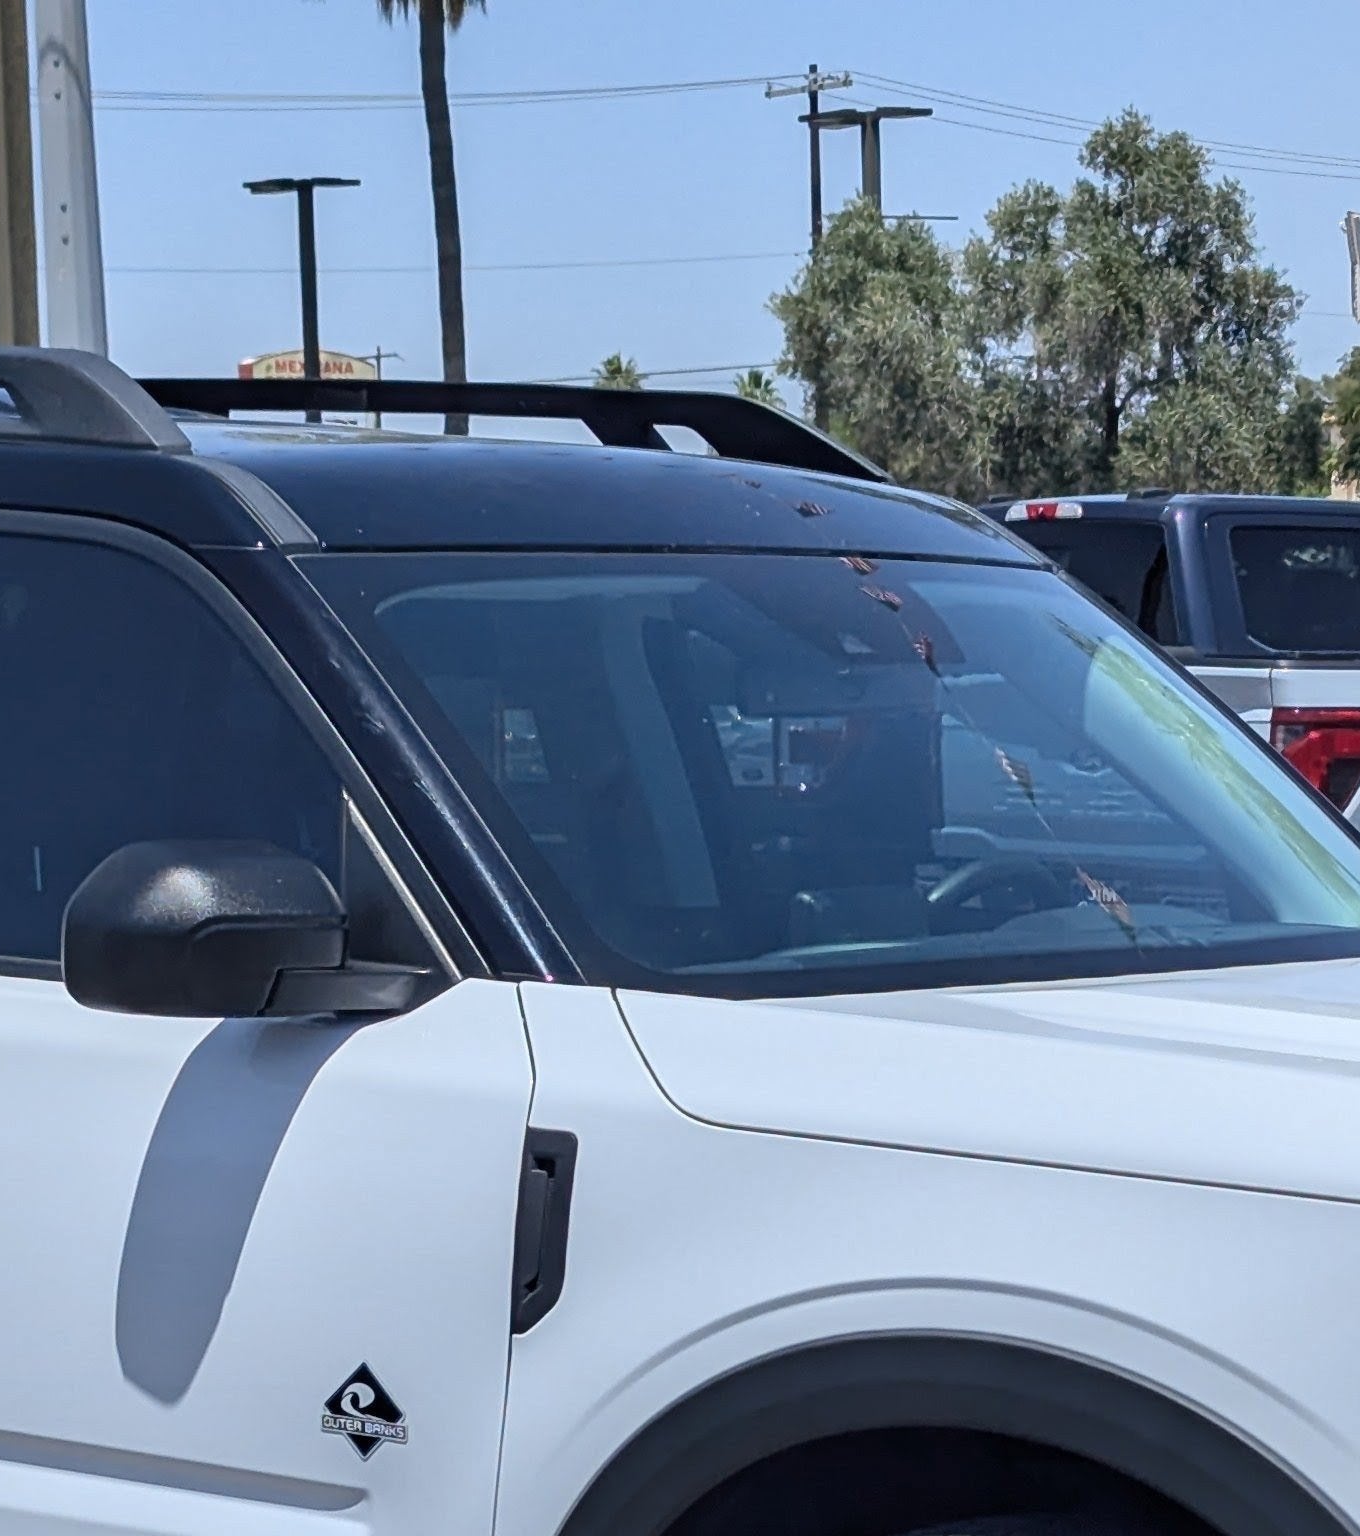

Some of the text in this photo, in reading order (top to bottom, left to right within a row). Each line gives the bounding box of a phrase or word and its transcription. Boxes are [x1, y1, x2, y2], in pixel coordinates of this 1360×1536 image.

[274, 360, 354, 376] MEXANA
[322, 1415, 405, 1438] OUTER BANKS
